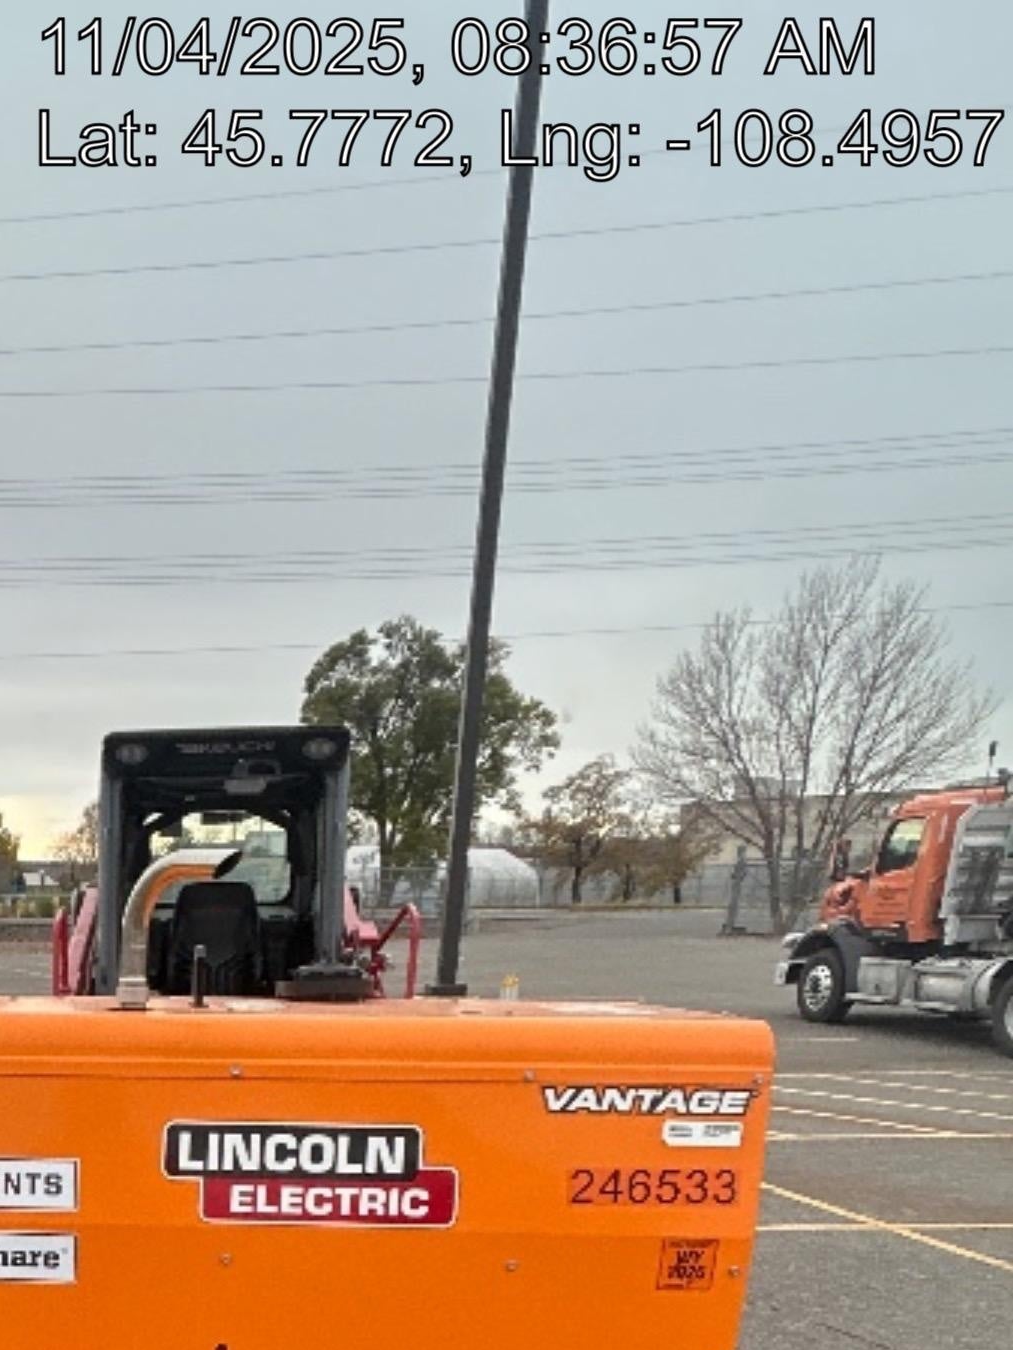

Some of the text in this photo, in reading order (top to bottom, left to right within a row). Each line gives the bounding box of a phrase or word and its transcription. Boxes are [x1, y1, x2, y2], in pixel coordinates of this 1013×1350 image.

[543, 1085, 752, 1116] VANTAGE
[177, 1131, 406, 1175] LINCOLN
[229, 1184, 430, 1217] ELECTRIC
[570, 1169, 736, 1205] 246533
